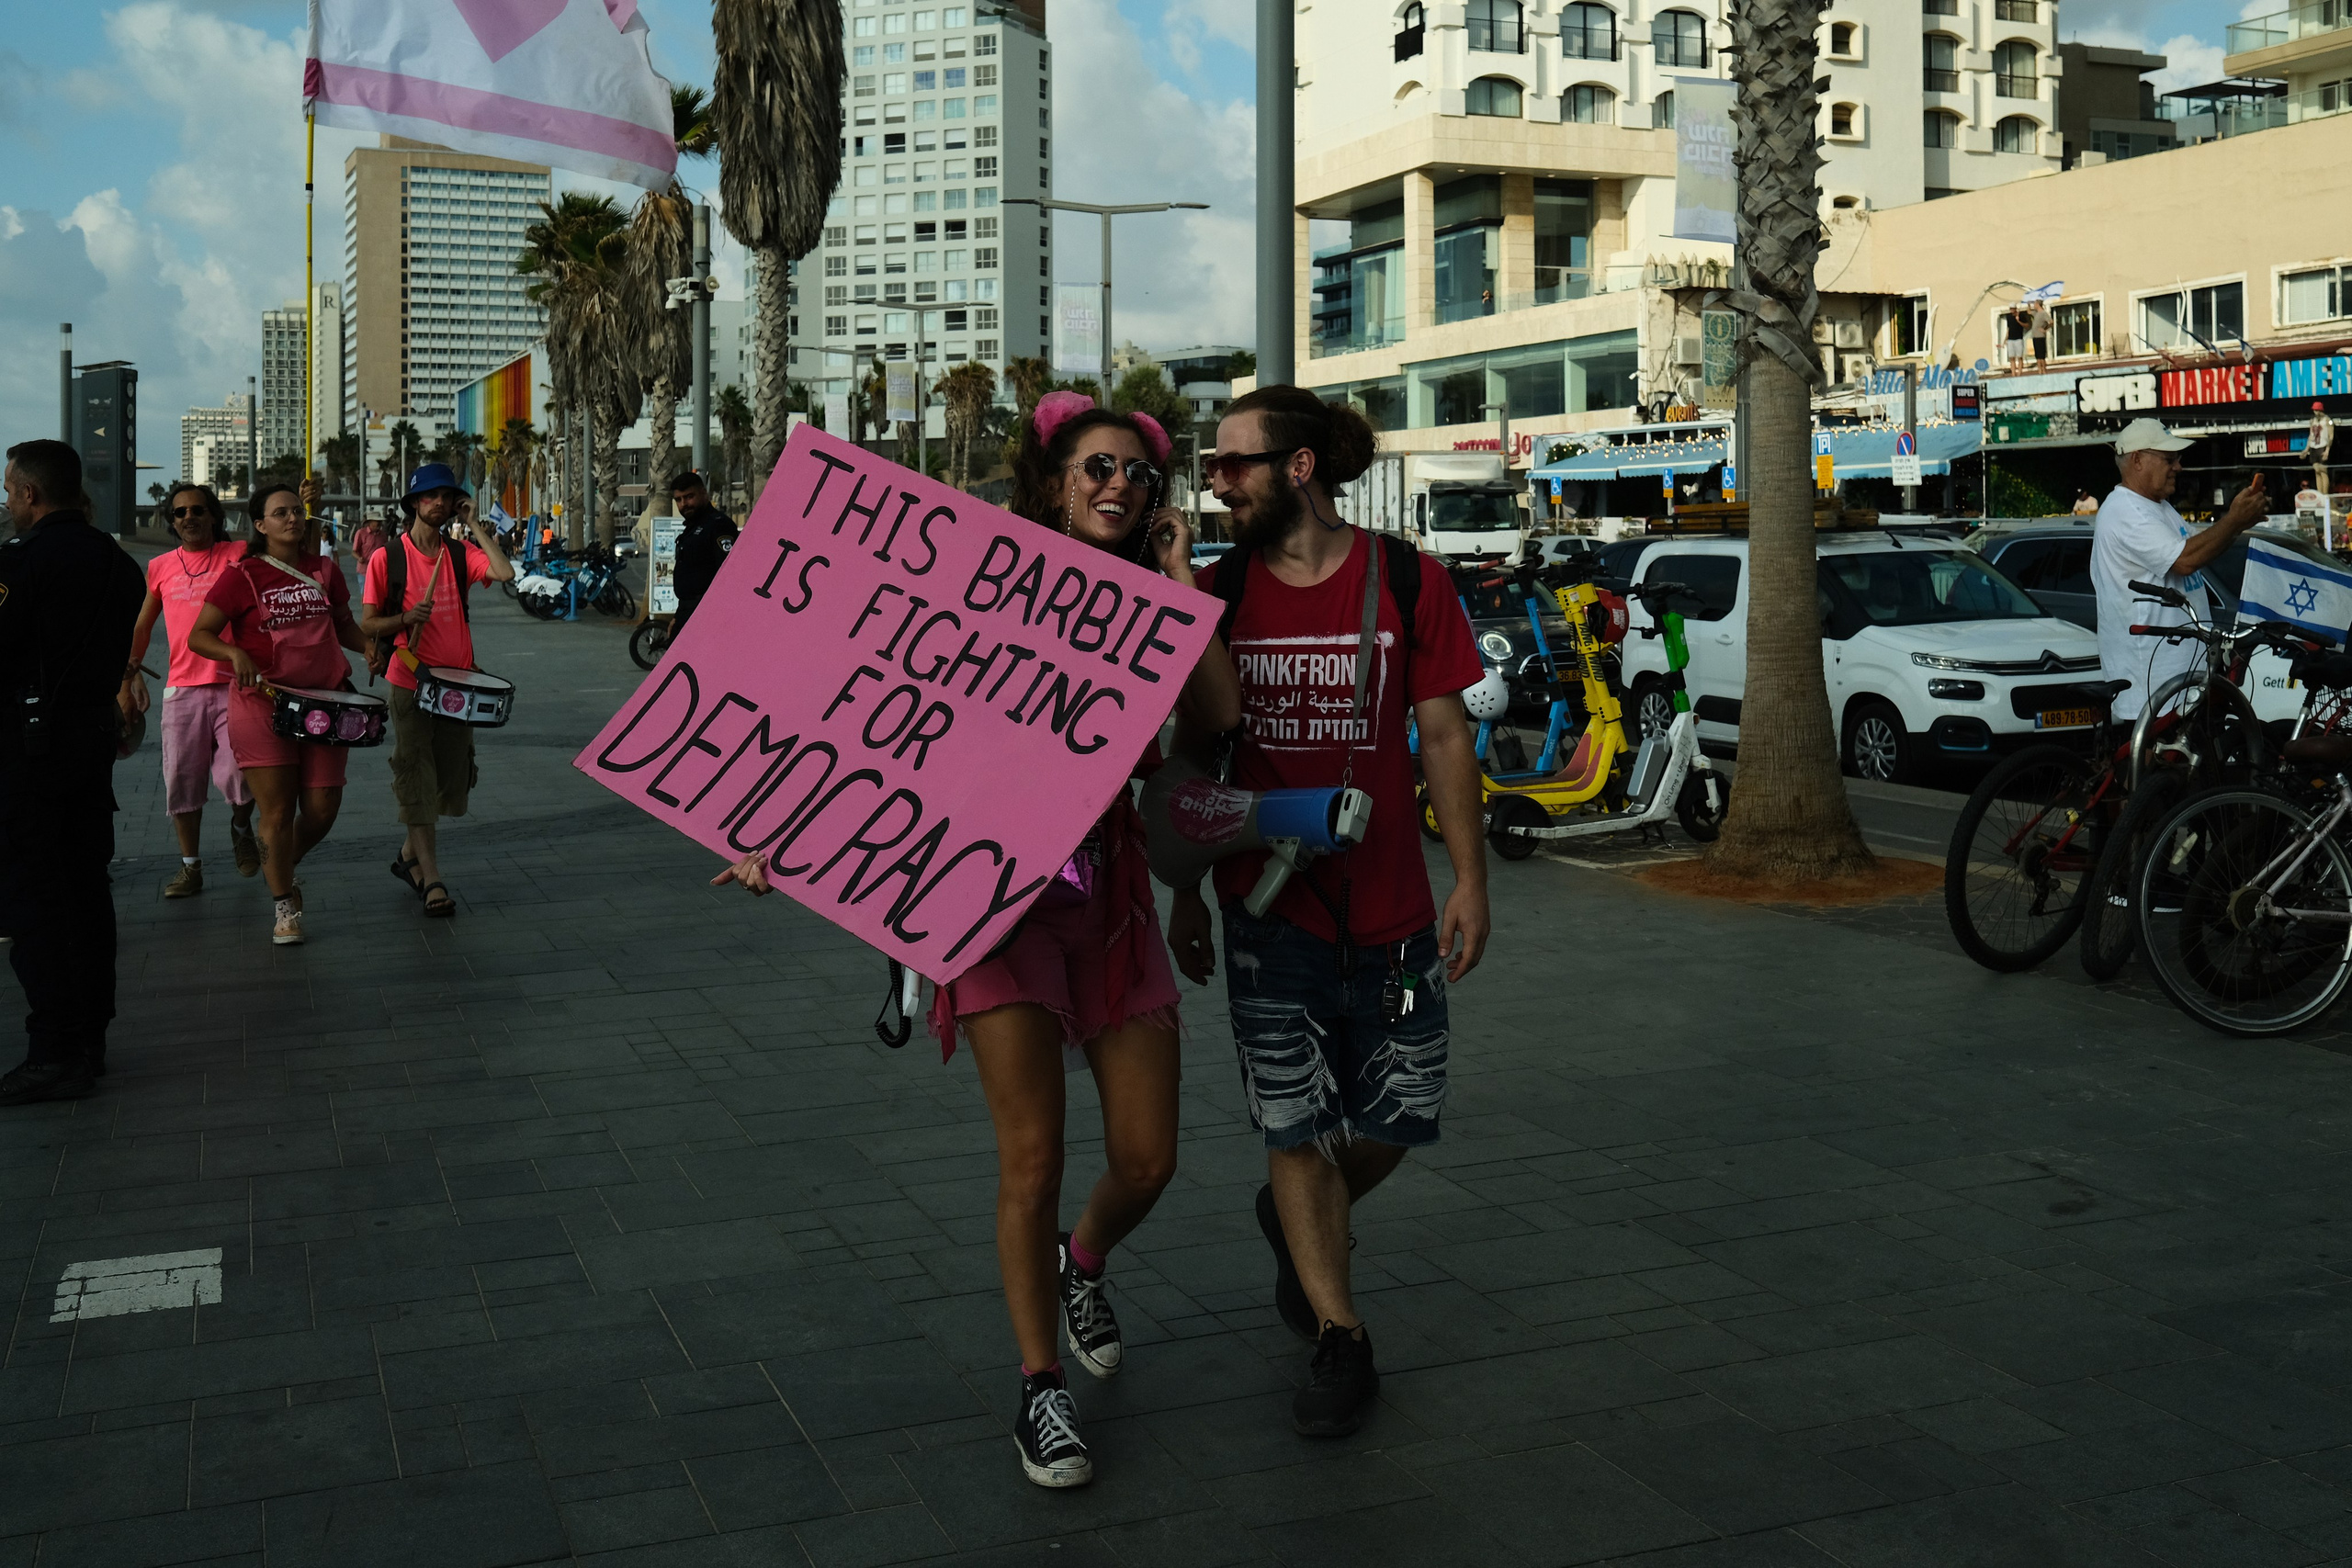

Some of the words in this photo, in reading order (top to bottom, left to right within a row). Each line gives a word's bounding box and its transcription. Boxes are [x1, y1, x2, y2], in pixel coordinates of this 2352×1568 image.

[323, 294, 337, 309] R
[2079, 373, 2157, 413] SUPER
[2161, 363, 2268, 408] MARKET
[2272, 355, 2352, 399] AMER
[802, 449, 957, 577] THIS
[964, 536, 1196, 683] BARBIE
[269, 588, 323, 604] PINKFRON
[753, 538, 830, 614] IS
[848, 583, 1125, 754] FIGHTING
[1239, 653, 1359, 686] PINKFRON
[2263, 676, 2285, 689] Gett
[821, 665, 954, 771] FOR
[1308, 691, 1371, 714] اجبهة
[597, 661, 1047, 963] DEMOCRACY
